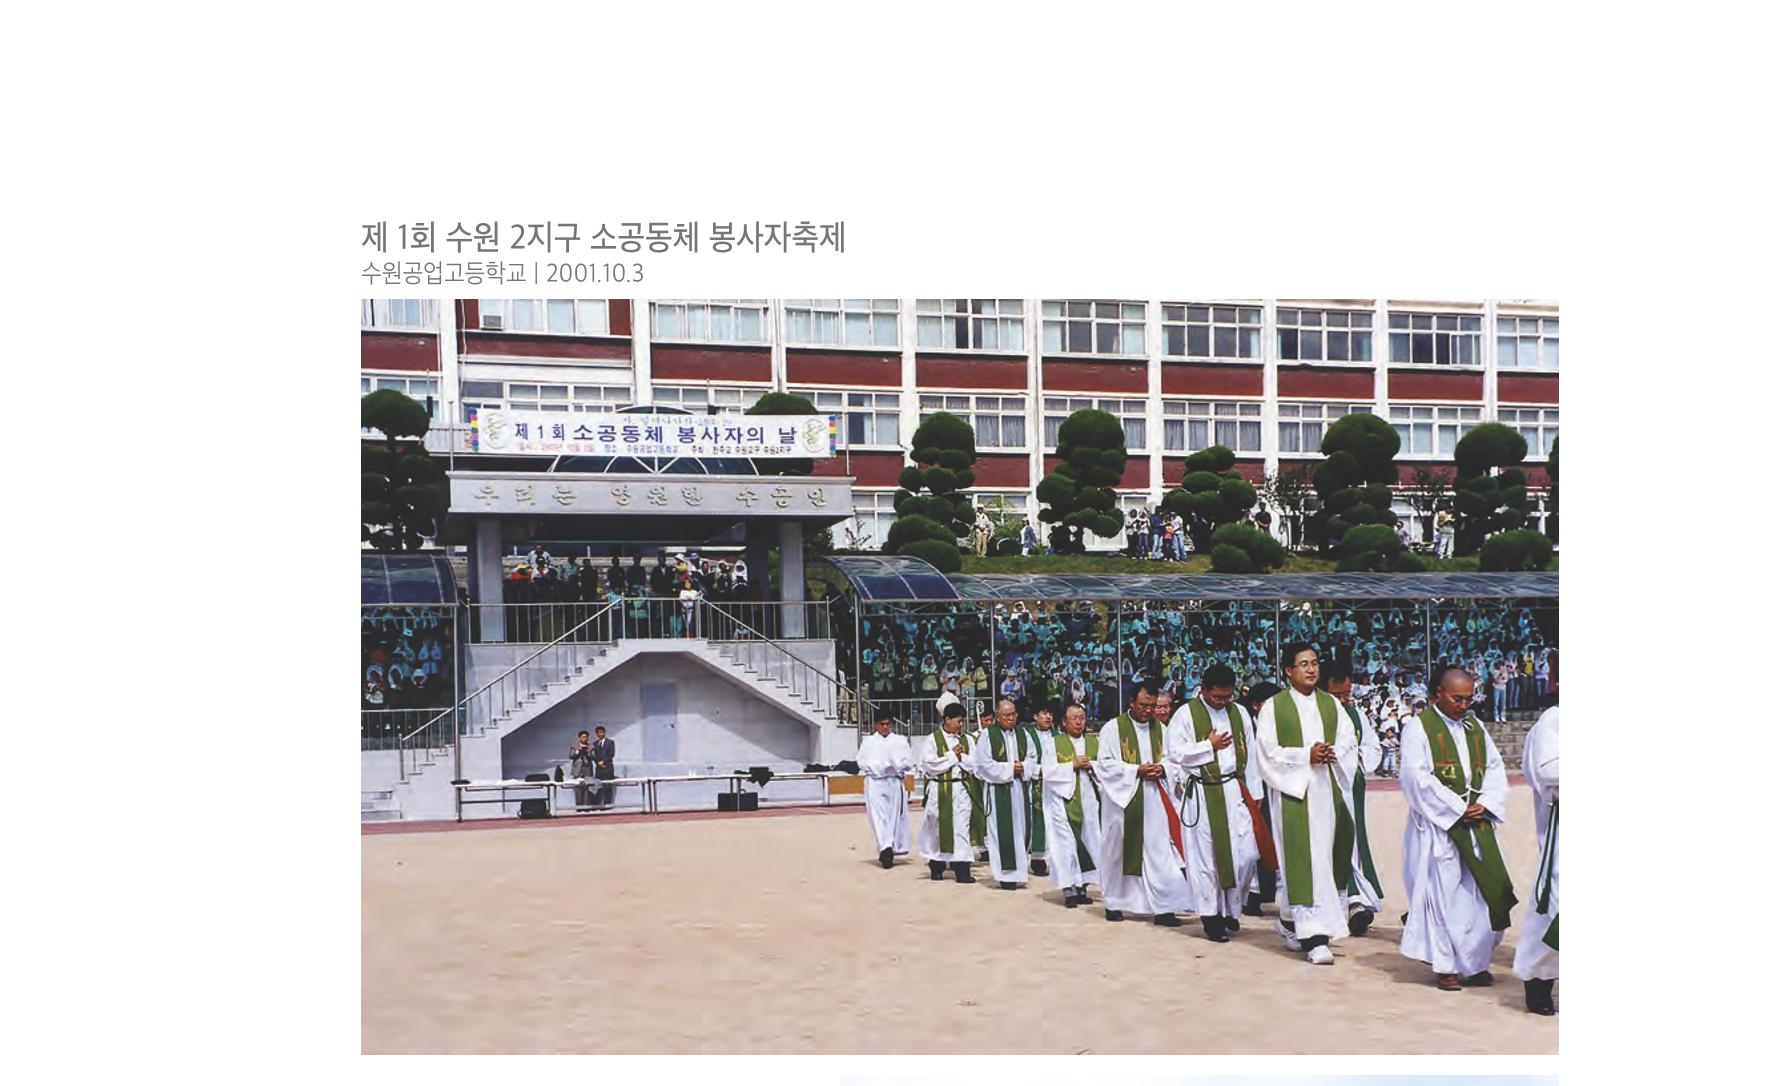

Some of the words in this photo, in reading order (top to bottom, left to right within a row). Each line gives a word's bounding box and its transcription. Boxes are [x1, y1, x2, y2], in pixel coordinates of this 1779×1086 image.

[573, 424, 663, 443] 소공동체
[677, 426, 764, 444] 봉사자의
[779, 427, 797, 444] 날
[475, 485, 577, 506] 우리는
[611, 485, 703, 507] 영원한
[736, 487, 828, 508] 수공인
